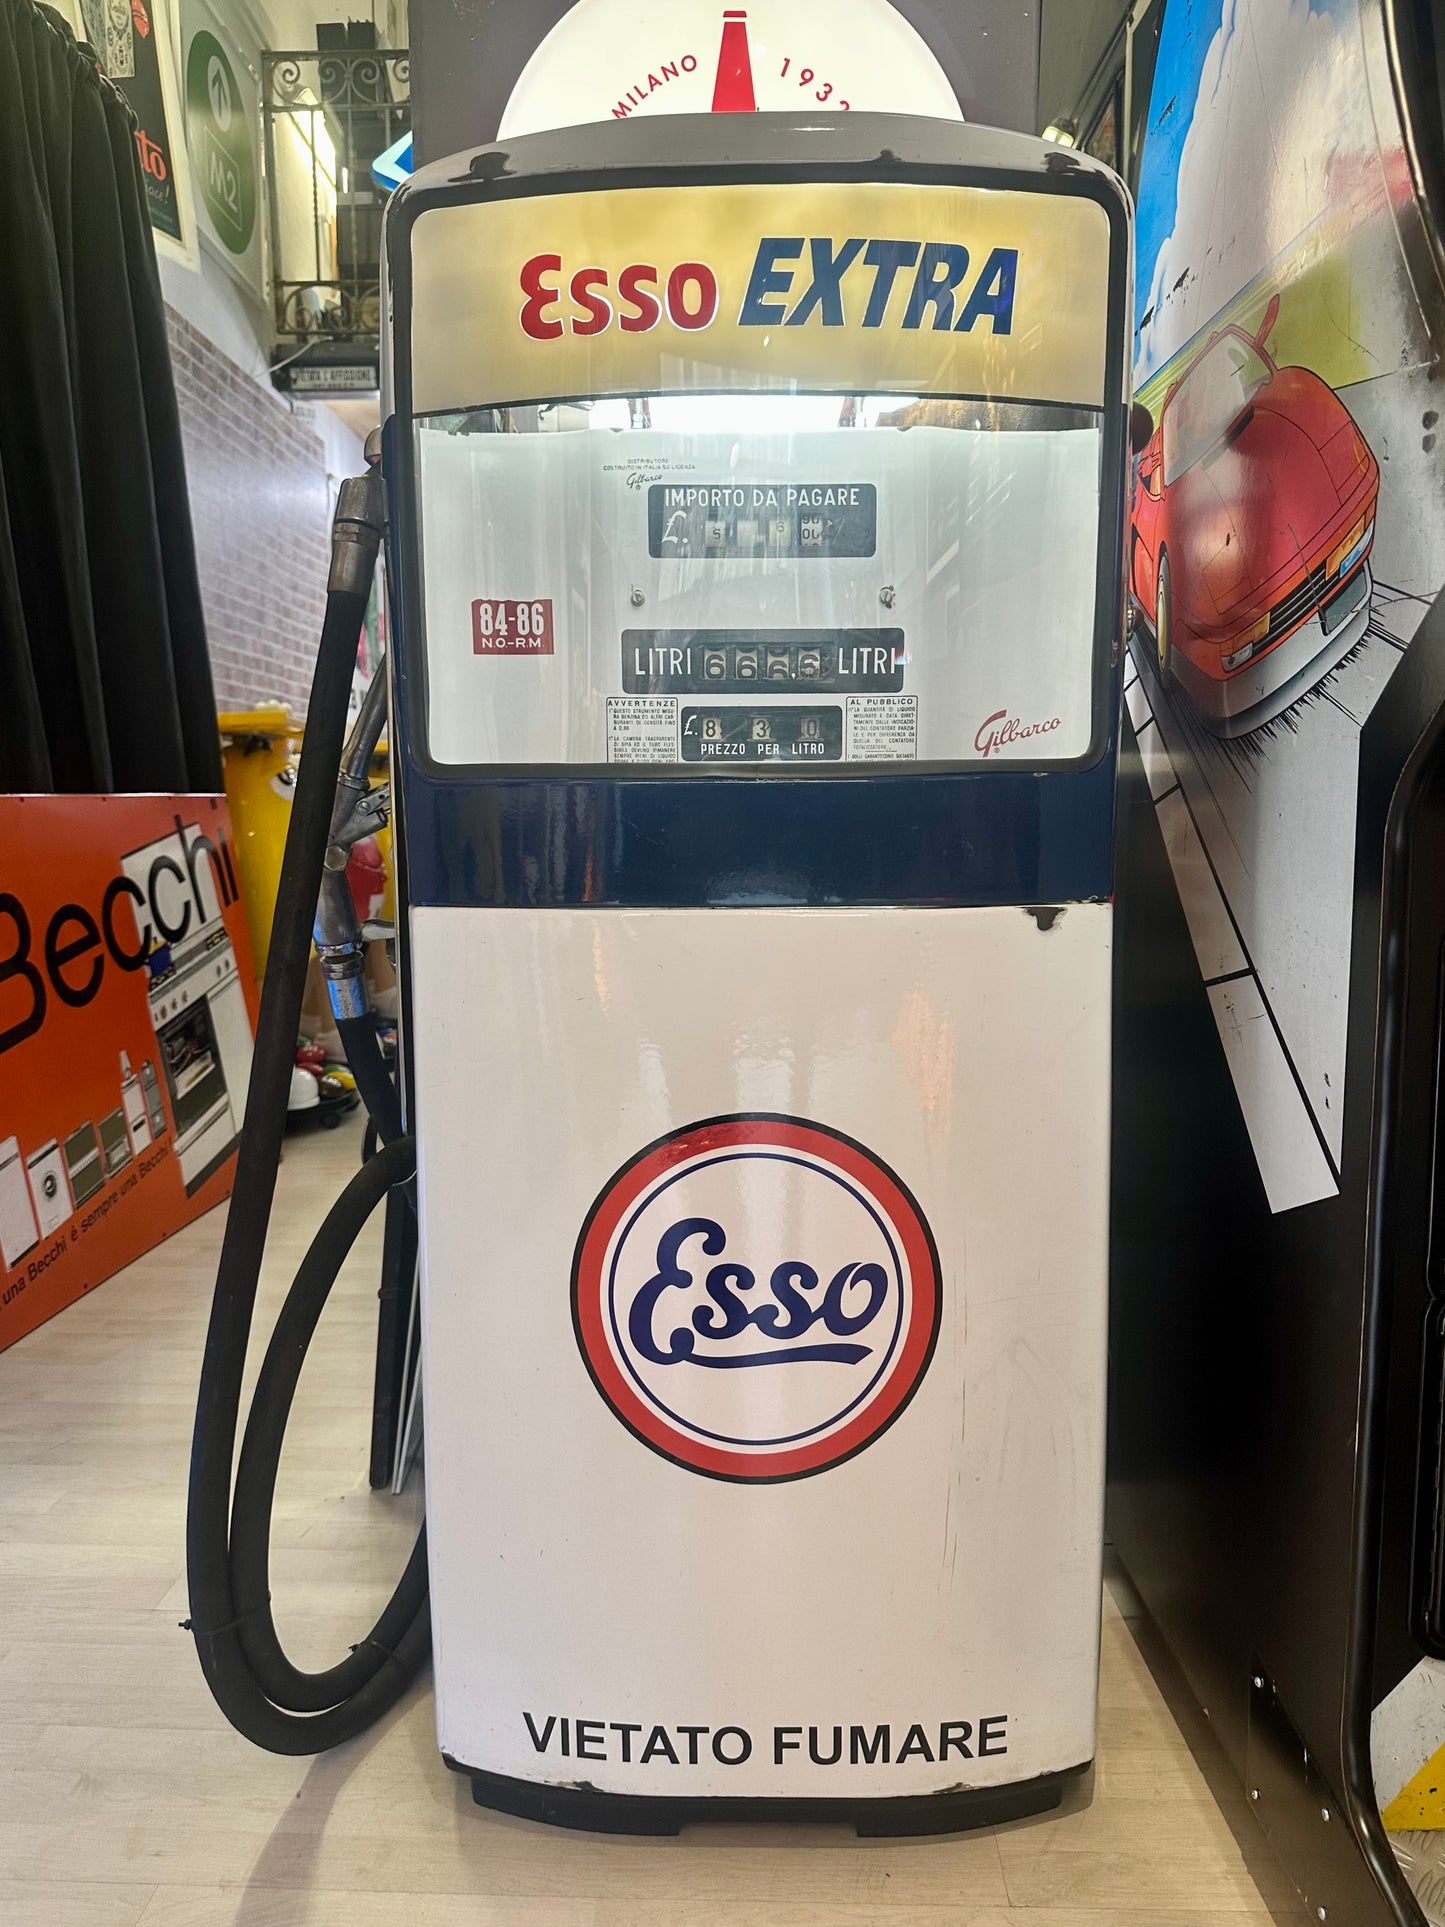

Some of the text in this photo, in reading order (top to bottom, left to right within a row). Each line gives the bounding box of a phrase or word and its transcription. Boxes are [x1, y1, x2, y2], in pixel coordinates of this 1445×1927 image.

[611, 55, 697, 119] MILANO
[211, 151, 238, 213] M2
[737, 238, 1019, 336] EXTRA
[626, 472, 663, 489] Gilbarco
[665, 488, 860, 507] IMPORTO DA PAGARE
[480, 603, 544, 636] 84-86
[635, 648, 691, 675] LITRI
[838, 647, 896, 675] LITRI
[701, 743, 825, 755] PREZZO PER LITRO
[706, 720, 715, 737] 8
[756, 720, 767, 738] 3
[975, 709, 1062, 758] Gilbarco
[0, 799, 239, 1055] Becchi
[3, 1278, 26, 1304] una
[28, 1235, 68, 1282] Becchi
[81, 1193, 119, 1233] sempre
[121, 1174, 138, 1196] una
[628, 1217, 889, 1369] Esso
[522, 1712, 1008, 1765] VIETATO FUMARE
